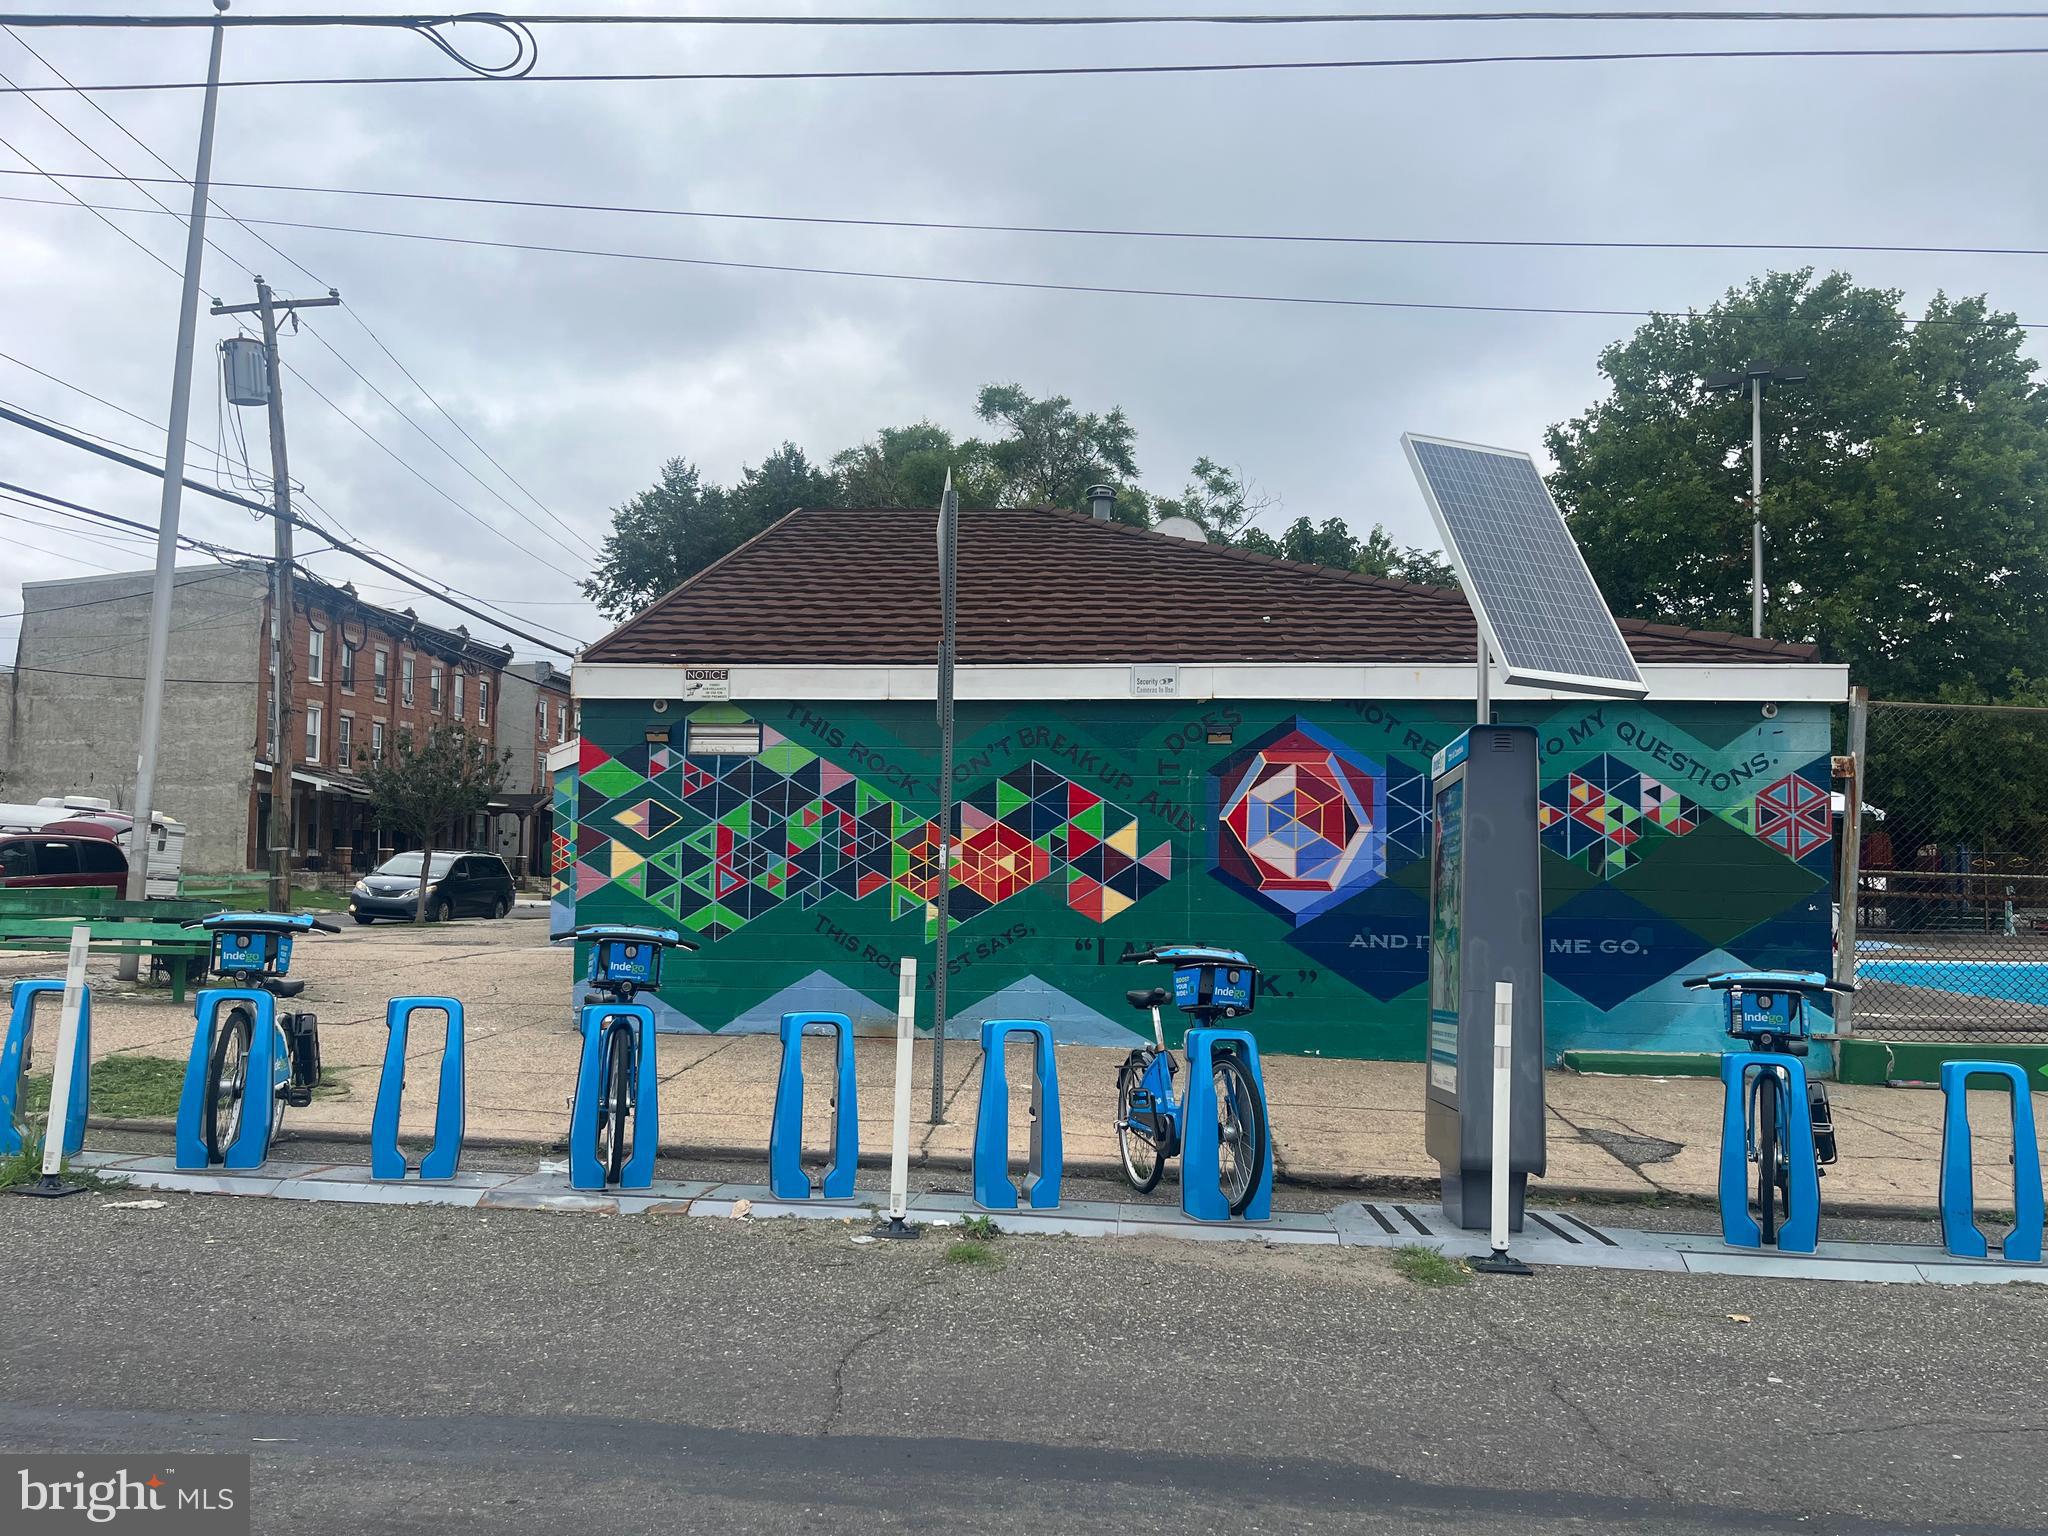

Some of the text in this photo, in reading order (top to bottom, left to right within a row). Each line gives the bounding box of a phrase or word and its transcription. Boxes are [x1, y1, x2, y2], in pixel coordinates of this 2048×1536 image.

[687, 670, 727, 680] NOTICE
[1136, 677, 1158, 686] Security
[785, 700, 847, 748] THIS
[848, 740, 921, 798] ROCK
[1016, 725, 1101, 773] BREAK
[1098, 762, 1134, 800] UP,
[1137, 790, 1195, 832] AND
[1158, 700, 1402, 786] IT DOES NOT
[1567, 708, 1606, 746] MY
[1616, 721, 1779, 792] QUESTIONS.
[816, 912, 860, 952] THIS
[975, 922, 1037, 959] SAYS,
[1349, 934, 1408, 949] AND
[1550, 938, 1591, 953] ME
[1599, 939, 1648, 955] GO.
